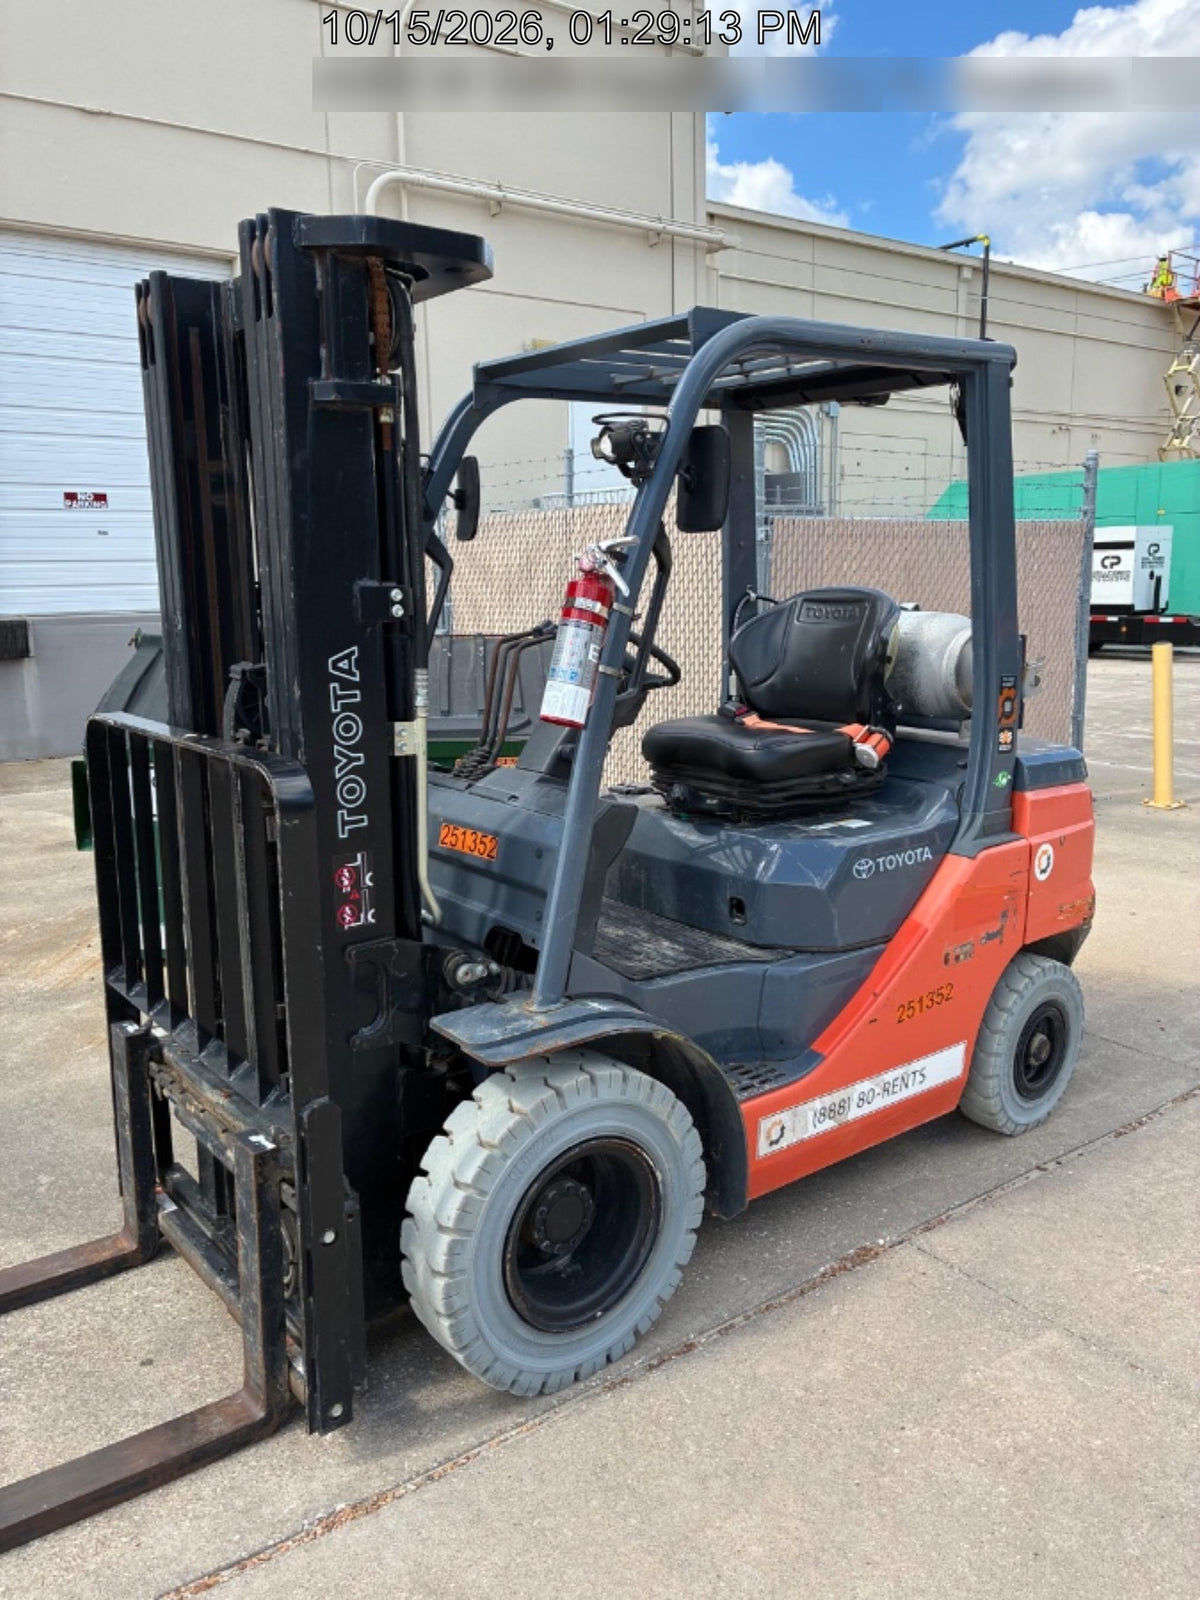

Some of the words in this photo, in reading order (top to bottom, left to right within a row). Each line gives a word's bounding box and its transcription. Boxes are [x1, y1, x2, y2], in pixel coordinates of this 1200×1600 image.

[328, 645, 369, 838] TOYOTA
[440, 824, 498, 860] 251352
[876, 845, 933, 873] TOYOTA
[896, 982, 954, 1025] 251352
[811, 1095, 853, 1130] (888)
[856, 1066, 927, 1109] 80-RENTS
